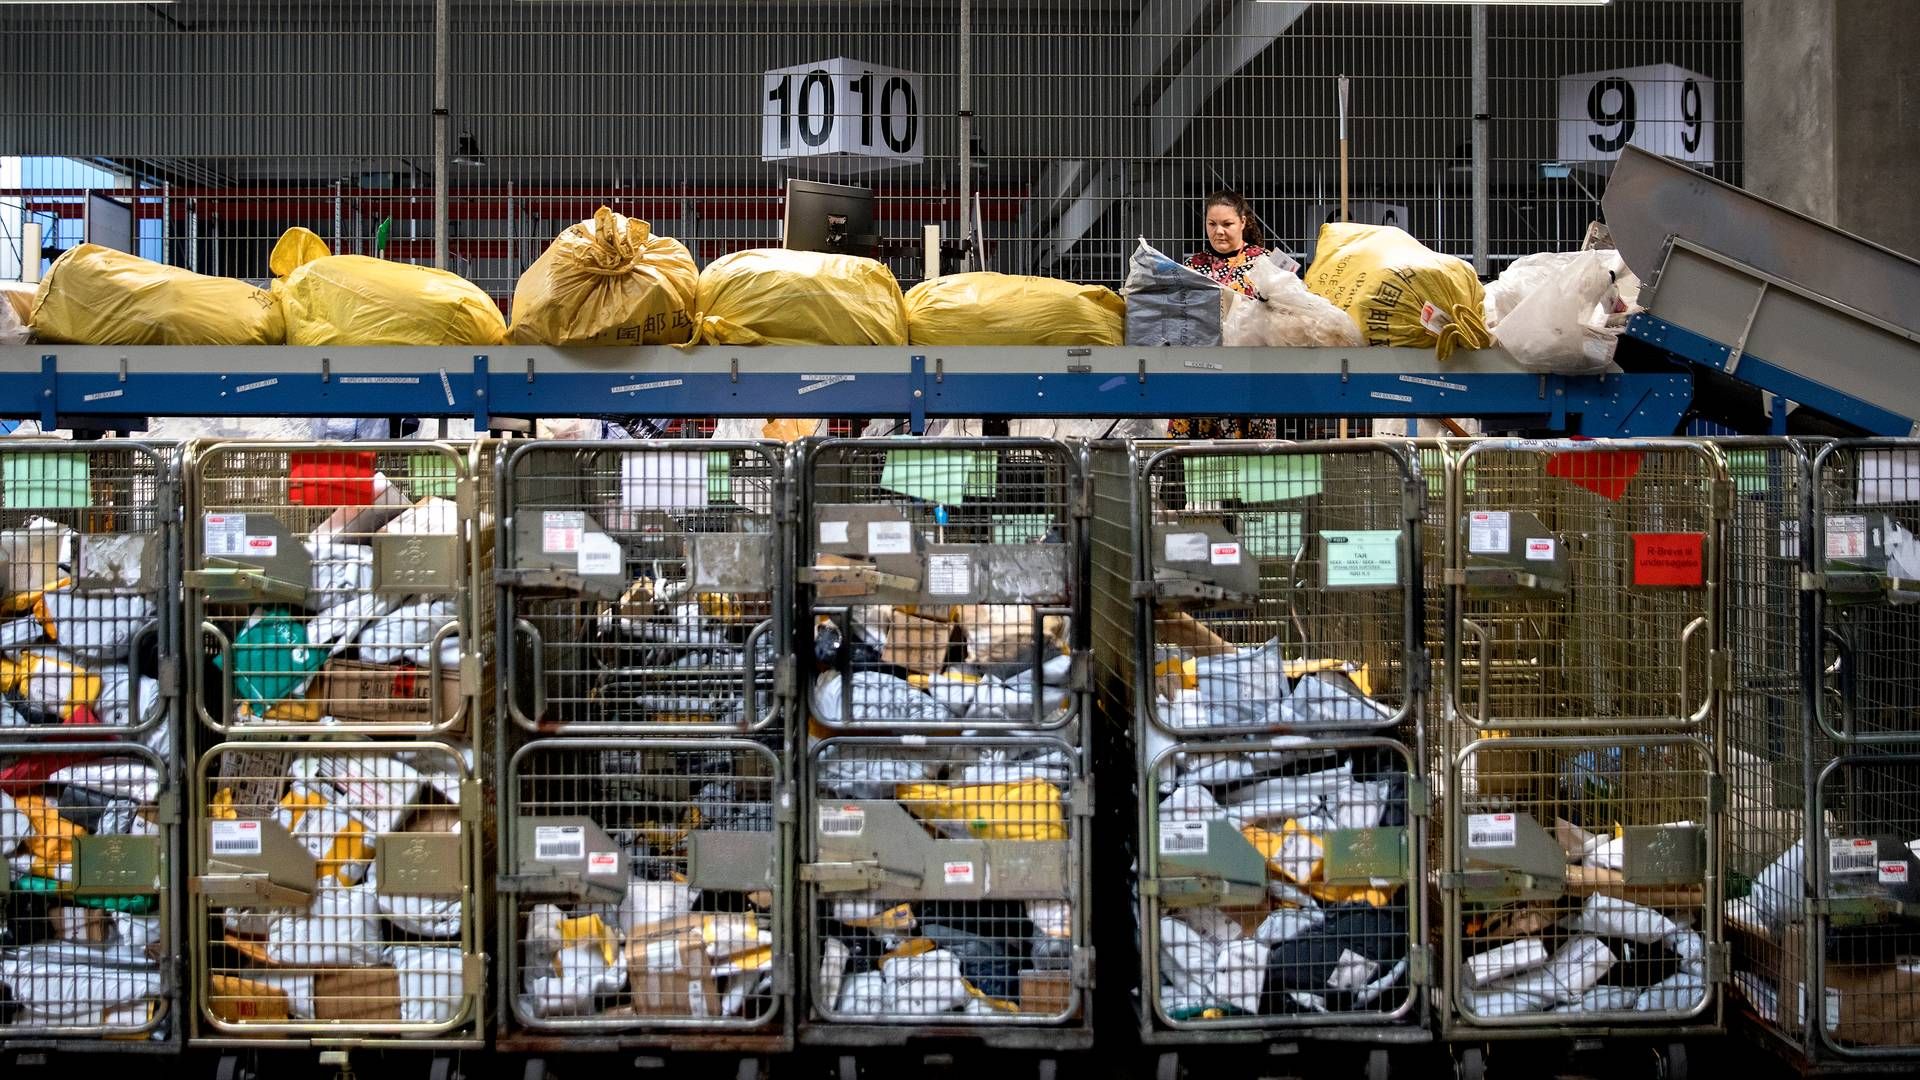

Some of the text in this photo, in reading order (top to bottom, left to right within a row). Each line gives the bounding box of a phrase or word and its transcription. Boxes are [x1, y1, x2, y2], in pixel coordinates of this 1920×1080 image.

[769, 70, 834, 149] 10
[850, 70, 917, 153] 10
[1588, 77, 1635, 152] 9
[1681, 78, 1701, 153] 9
